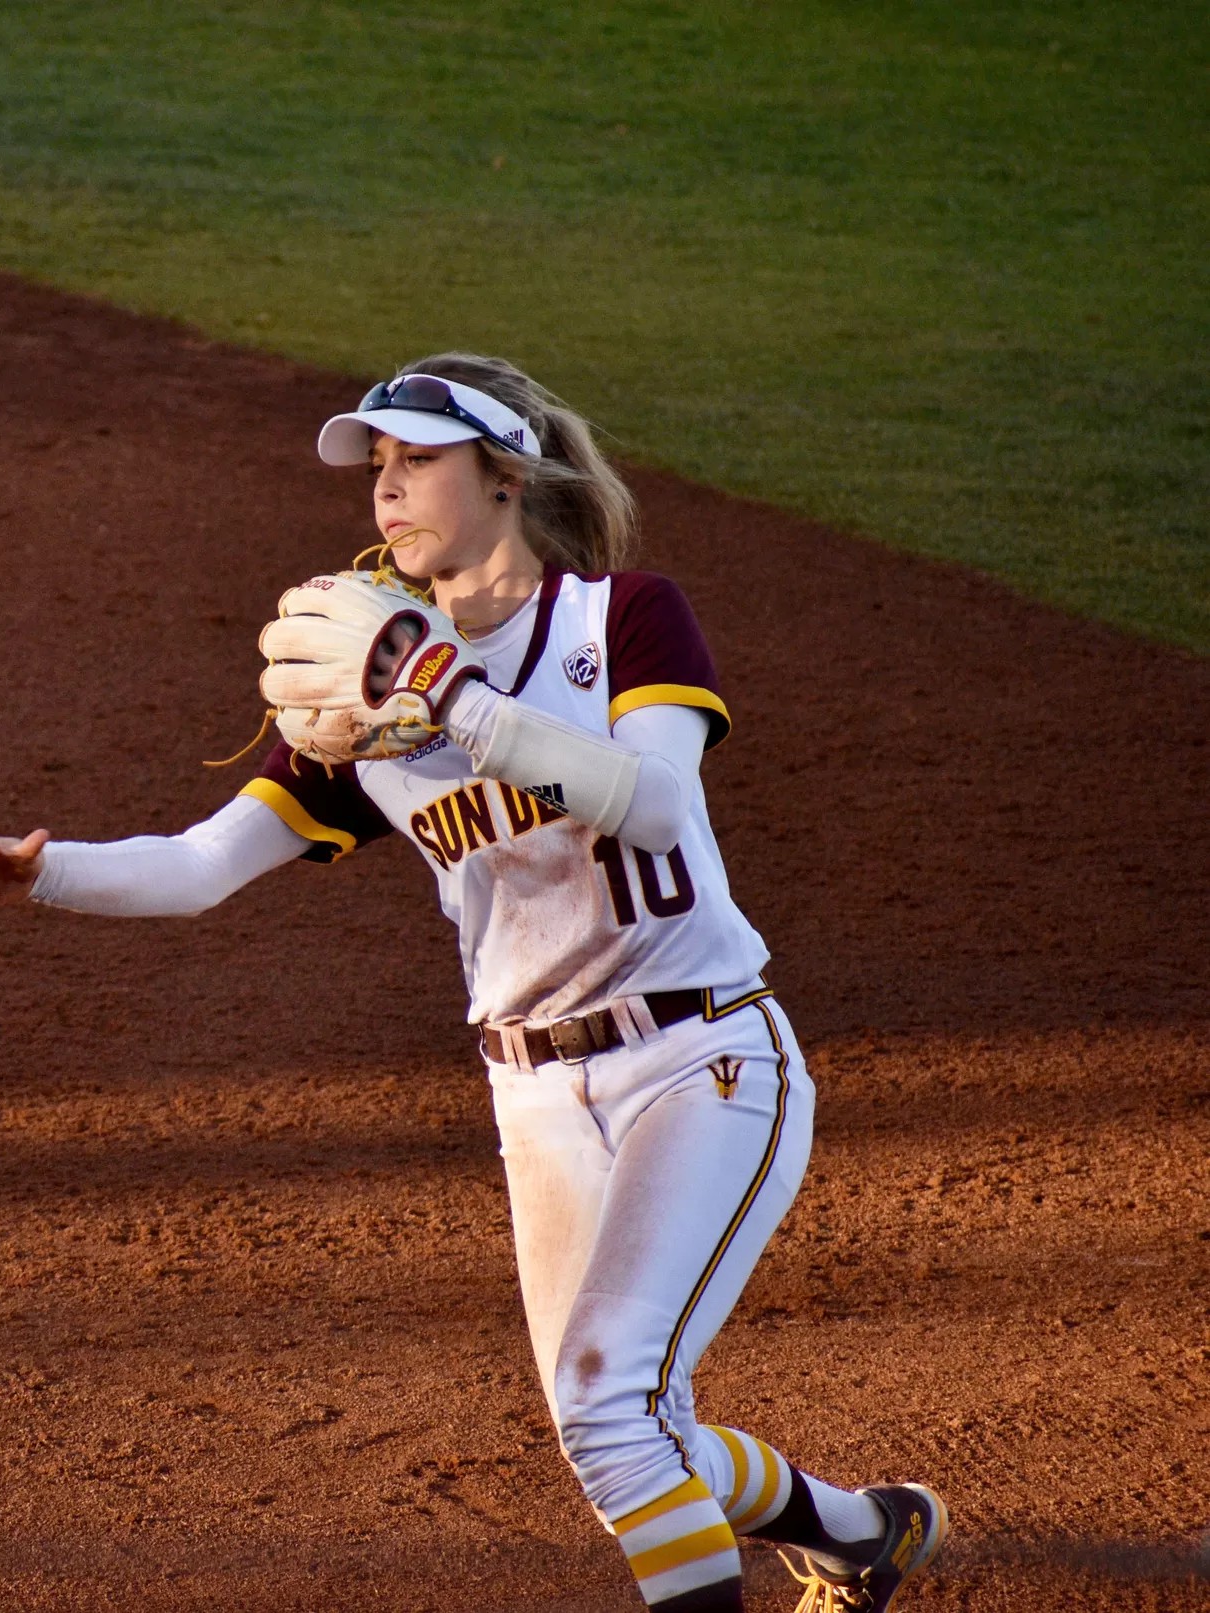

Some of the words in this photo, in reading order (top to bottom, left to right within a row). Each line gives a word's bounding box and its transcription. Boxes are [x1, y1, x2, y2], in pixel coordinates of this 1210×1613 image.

[411, 645, 454, 691] Wilson
[564, 644, 598, 680] PAC
[575, 662, 595, 684] 12
[405, 738, 448, 763] adidas
[523, 787, 569, 814] adidas
[410, 780, 499, 873] SUN
[591, 833, 696, 927] 10
